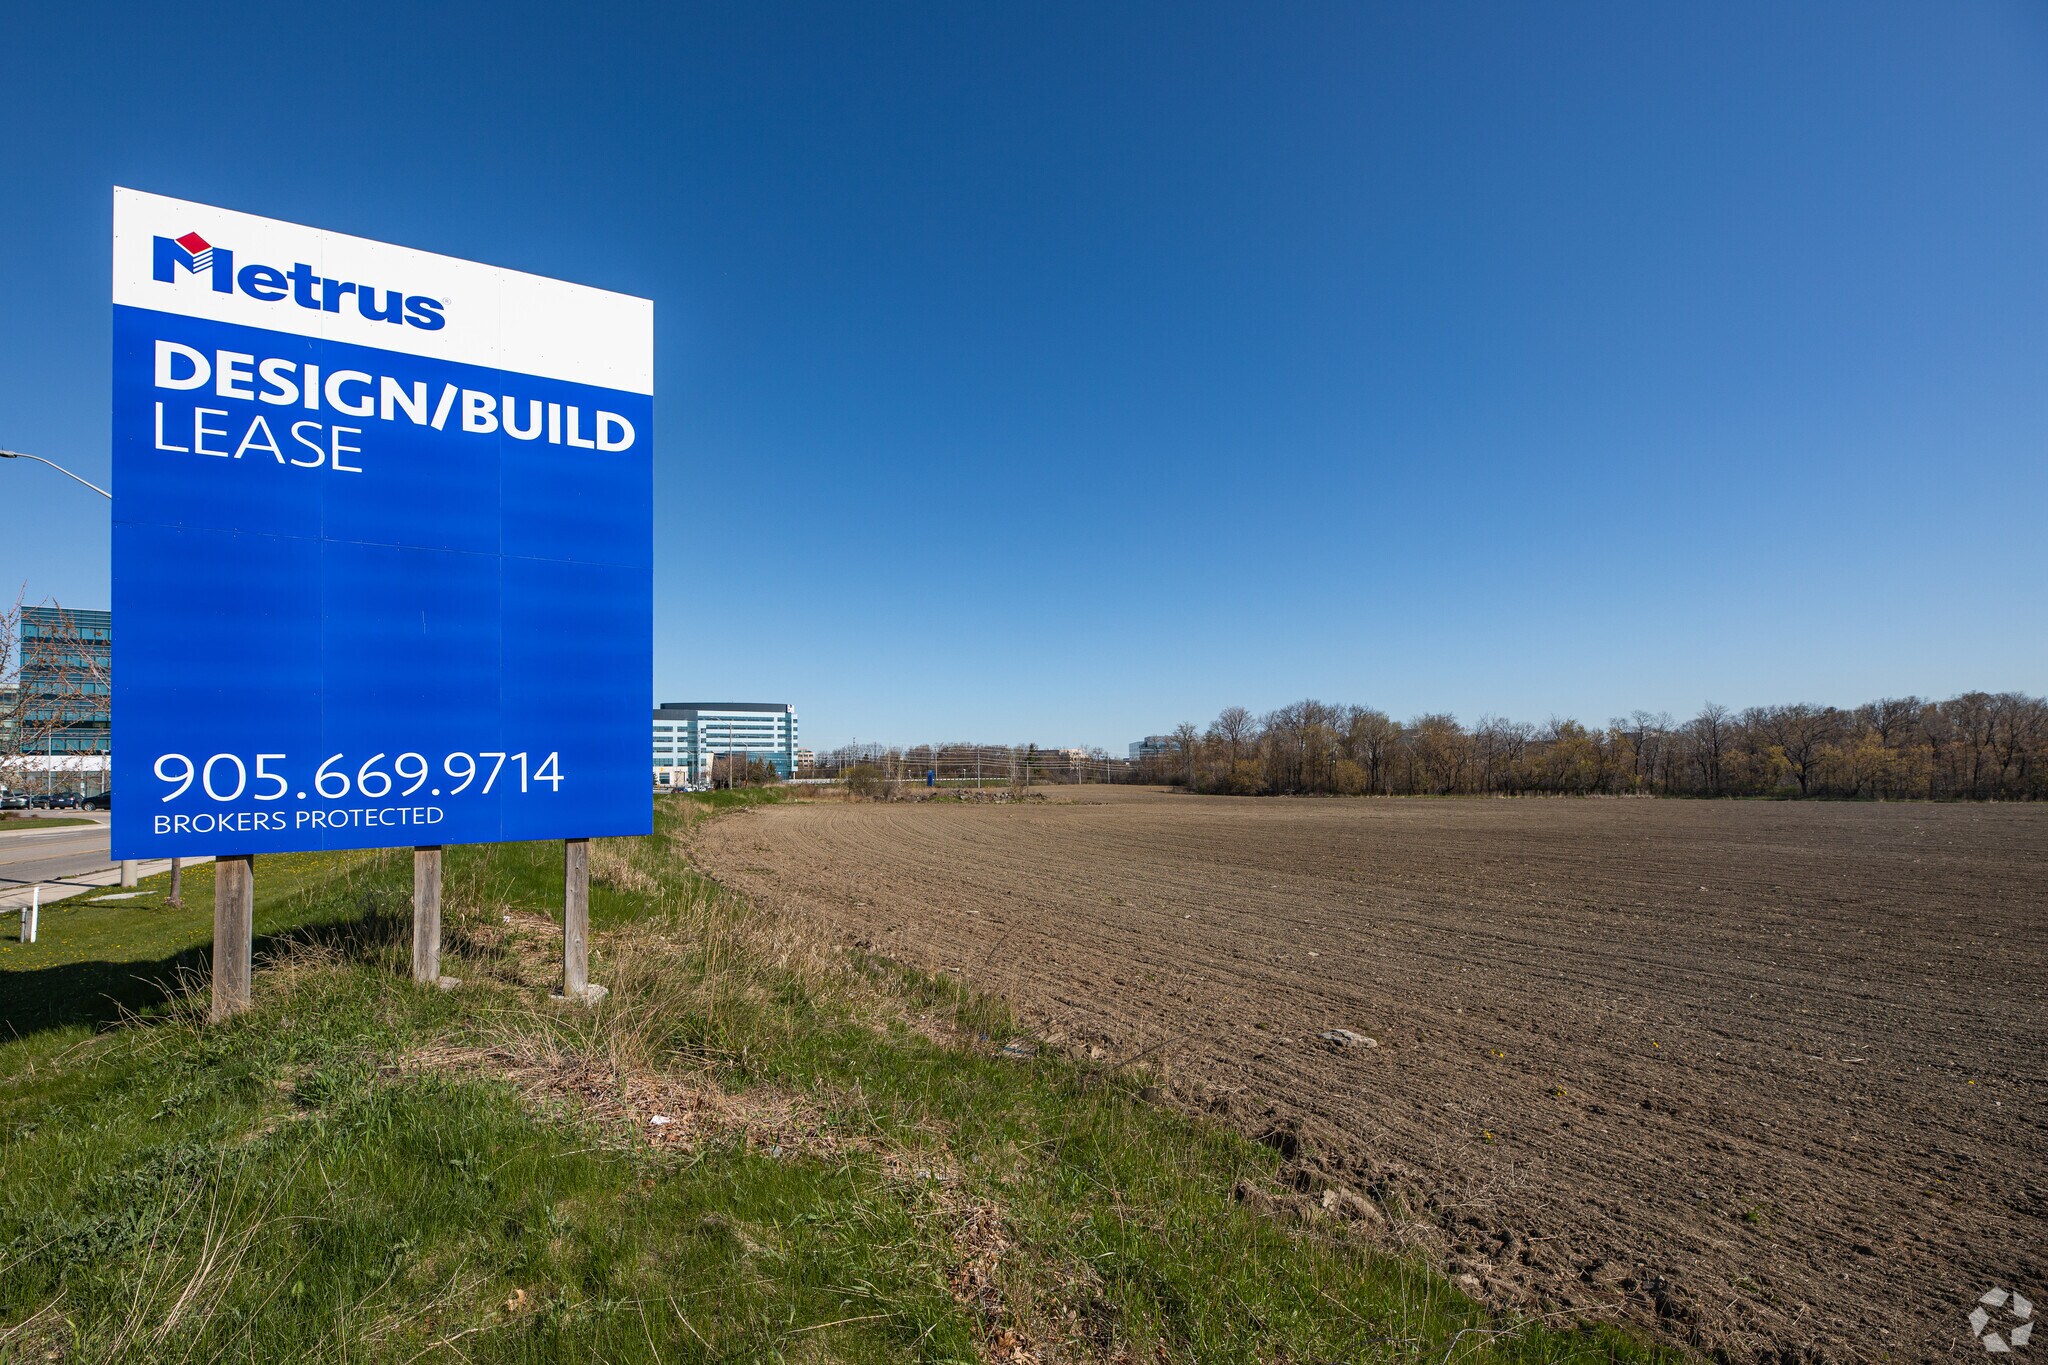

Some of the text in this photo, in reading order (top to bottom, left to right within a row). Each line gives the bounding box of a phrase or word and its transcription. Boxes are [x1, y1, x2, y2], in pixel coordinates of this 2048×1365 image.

[152, 231, 446, 331] Metrus
[155, 340, 635, 453] DESIGN/BUILD
[155, 401, 363, 473] LEASE
[153, 751, 564, 803] 905.669.9714
[154, 807, 444, 835] BROKERS PROTECTED
